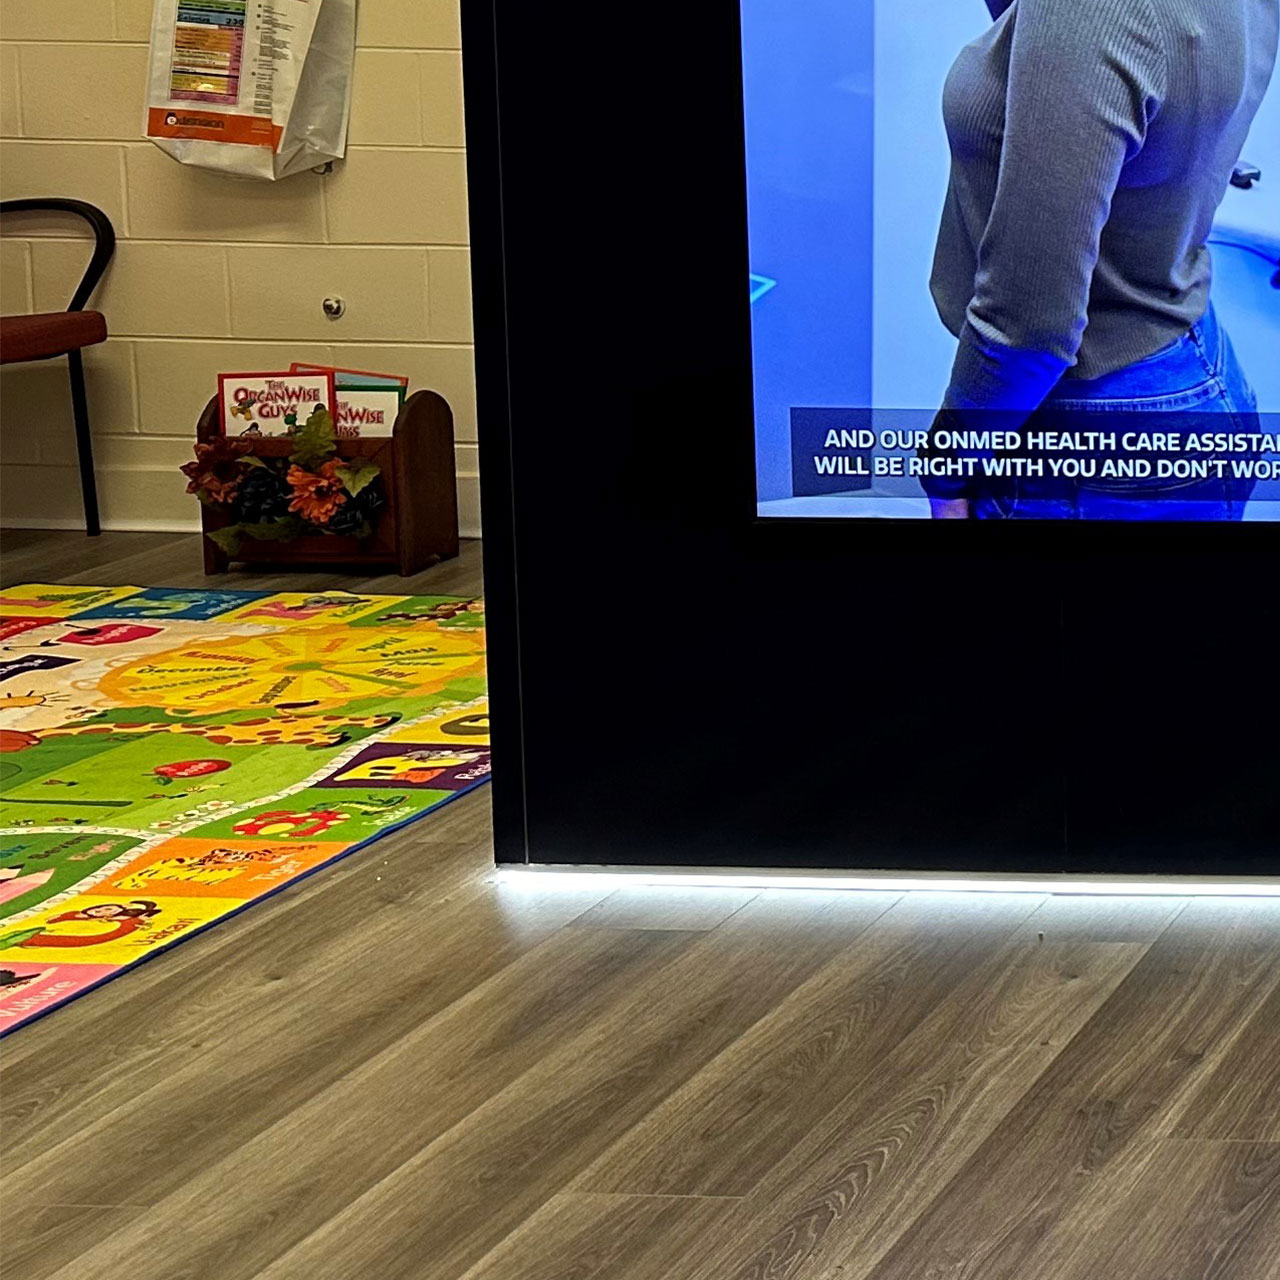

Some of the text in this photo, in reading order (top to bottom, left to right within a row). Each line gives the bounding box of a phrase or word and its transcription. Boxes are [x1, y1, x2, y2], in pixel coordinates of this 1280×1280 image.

[823, 429, 875, 448] AND
[880, 430, 929, 449] OUR
[934, 431, 1021, 450] ONMED
[1027, 431, 1116, 451] HEALTH
[1121, 432, 1181, 451] CARE
[814, 456, 869, 475] WILL
[874, 457, 903, 475] BE
[909, 457, 979, 476] RIGHT
[982, 458, 1042, 477] WITH
[1048, 458, 1096, 477] YOU
[1100, 459, 1151, 478] AND
[1157, 459, 1228, 478] DON'T
